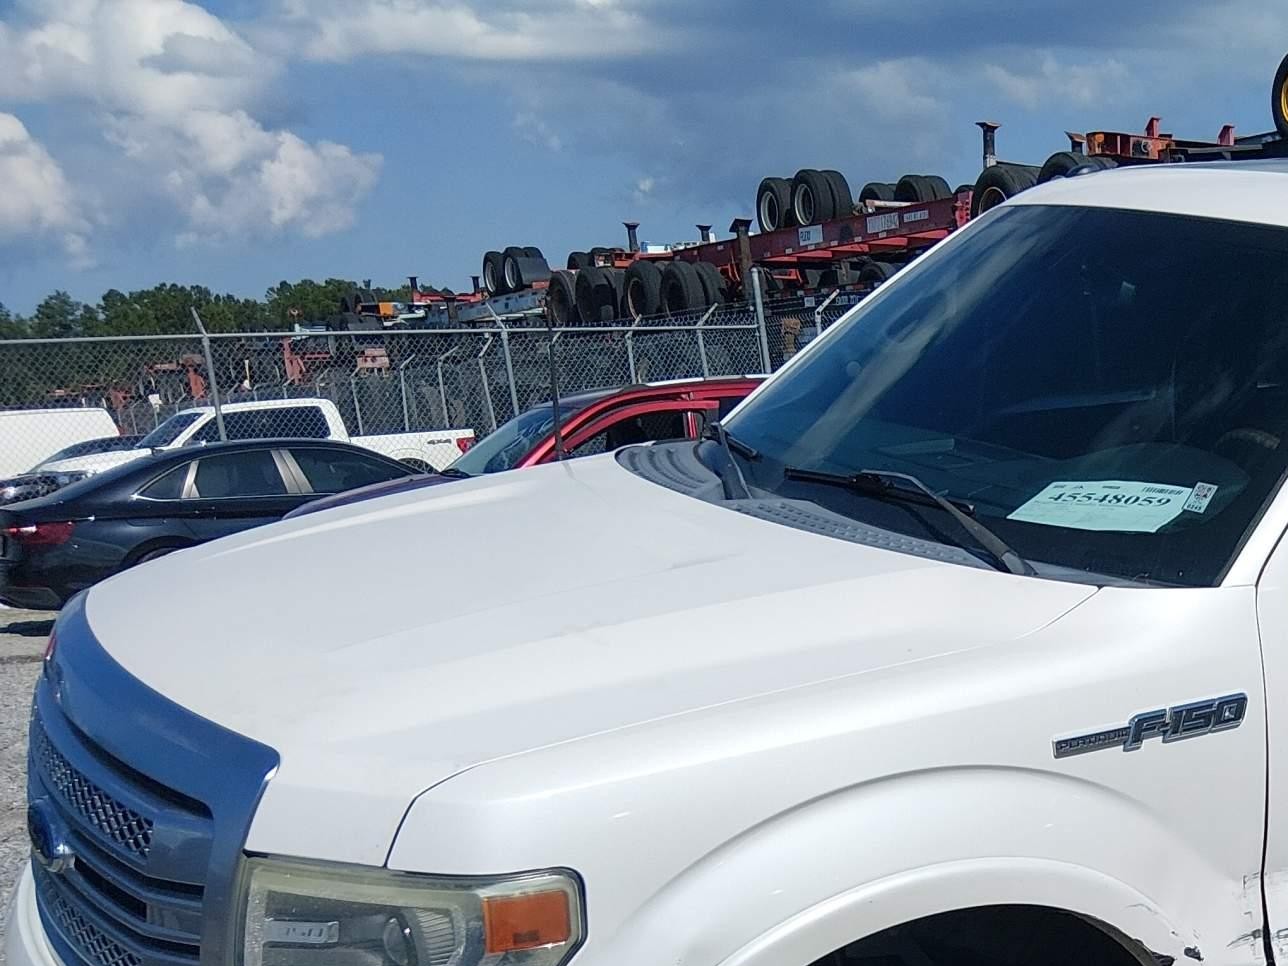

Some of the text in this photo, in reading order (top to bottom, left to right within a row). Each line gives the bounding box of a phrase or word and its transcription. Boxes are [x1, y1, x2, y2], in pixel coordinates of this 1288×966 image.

[1049, 491, 1172, 507] 45548059
[1057, 691, 1249, 753] PLATINUM F-150
